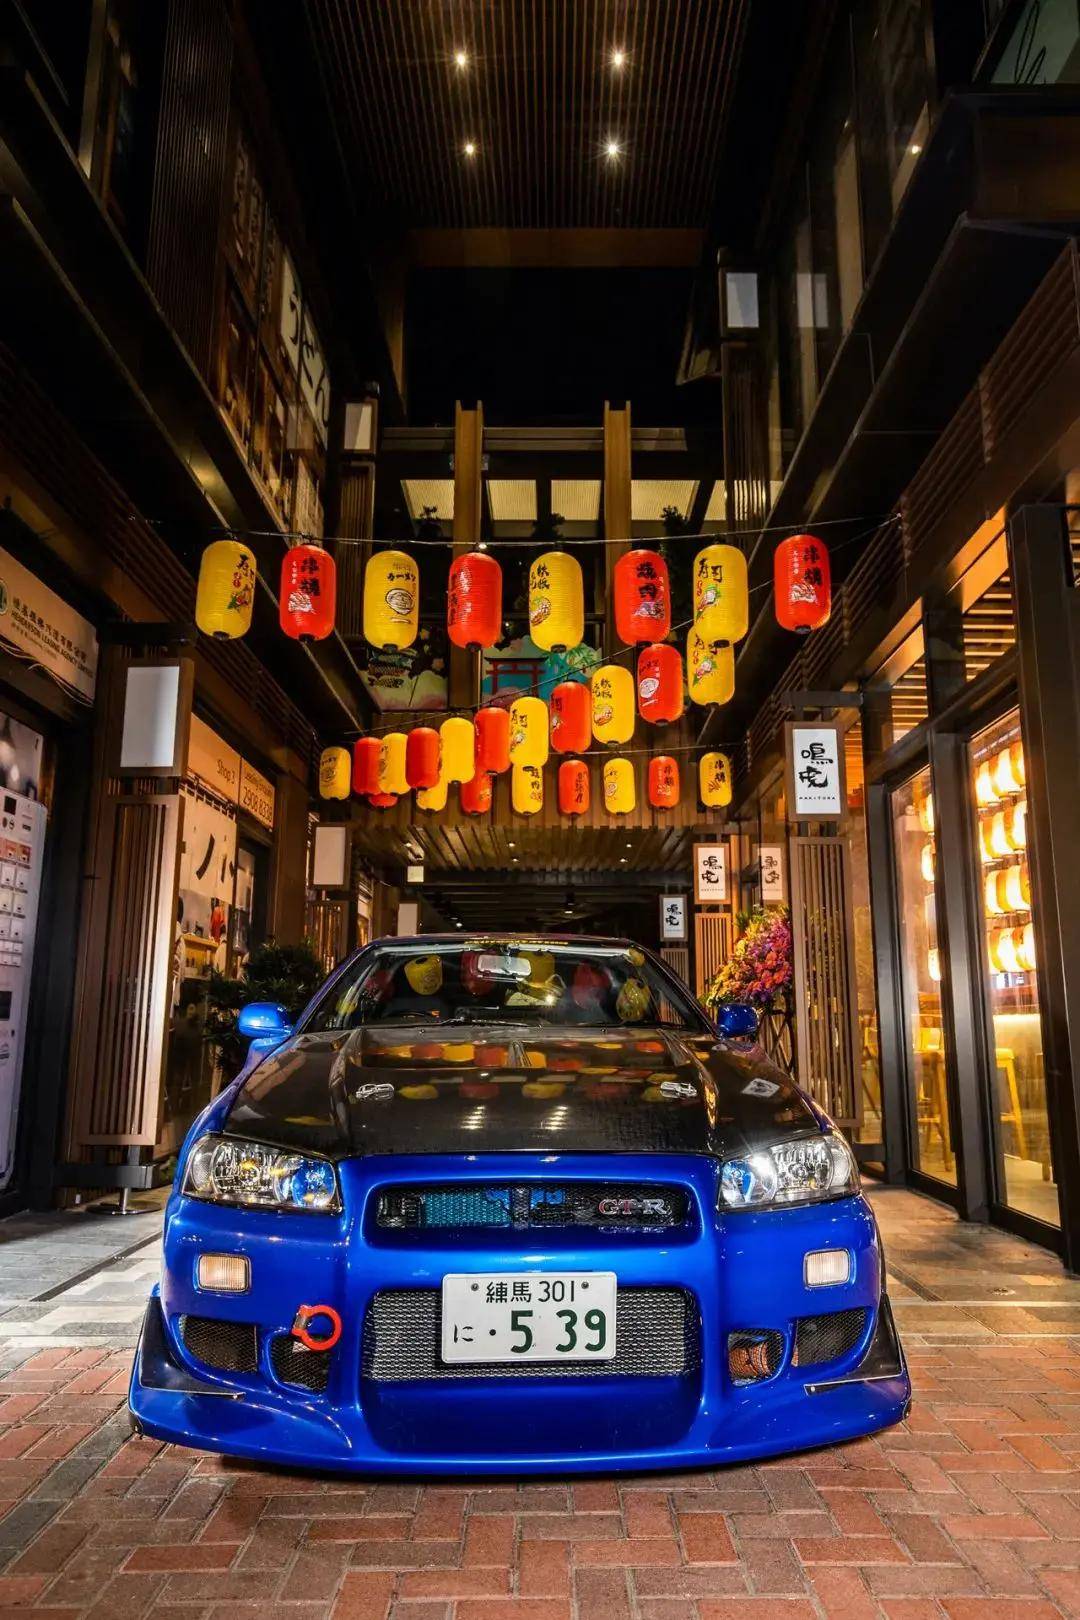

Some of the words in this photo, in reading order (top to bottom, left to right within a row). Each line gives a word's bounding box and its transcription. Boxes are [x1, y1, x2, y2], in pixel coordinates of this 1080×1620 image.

[216, 759, 230, 782] Shop
[598, 1198, 668, 1215] GT-R
[485, 1281, 532, 1304] 練馬
[537, 1280, 575, 1303] 301
[453, 1323, 474, 1344] に
